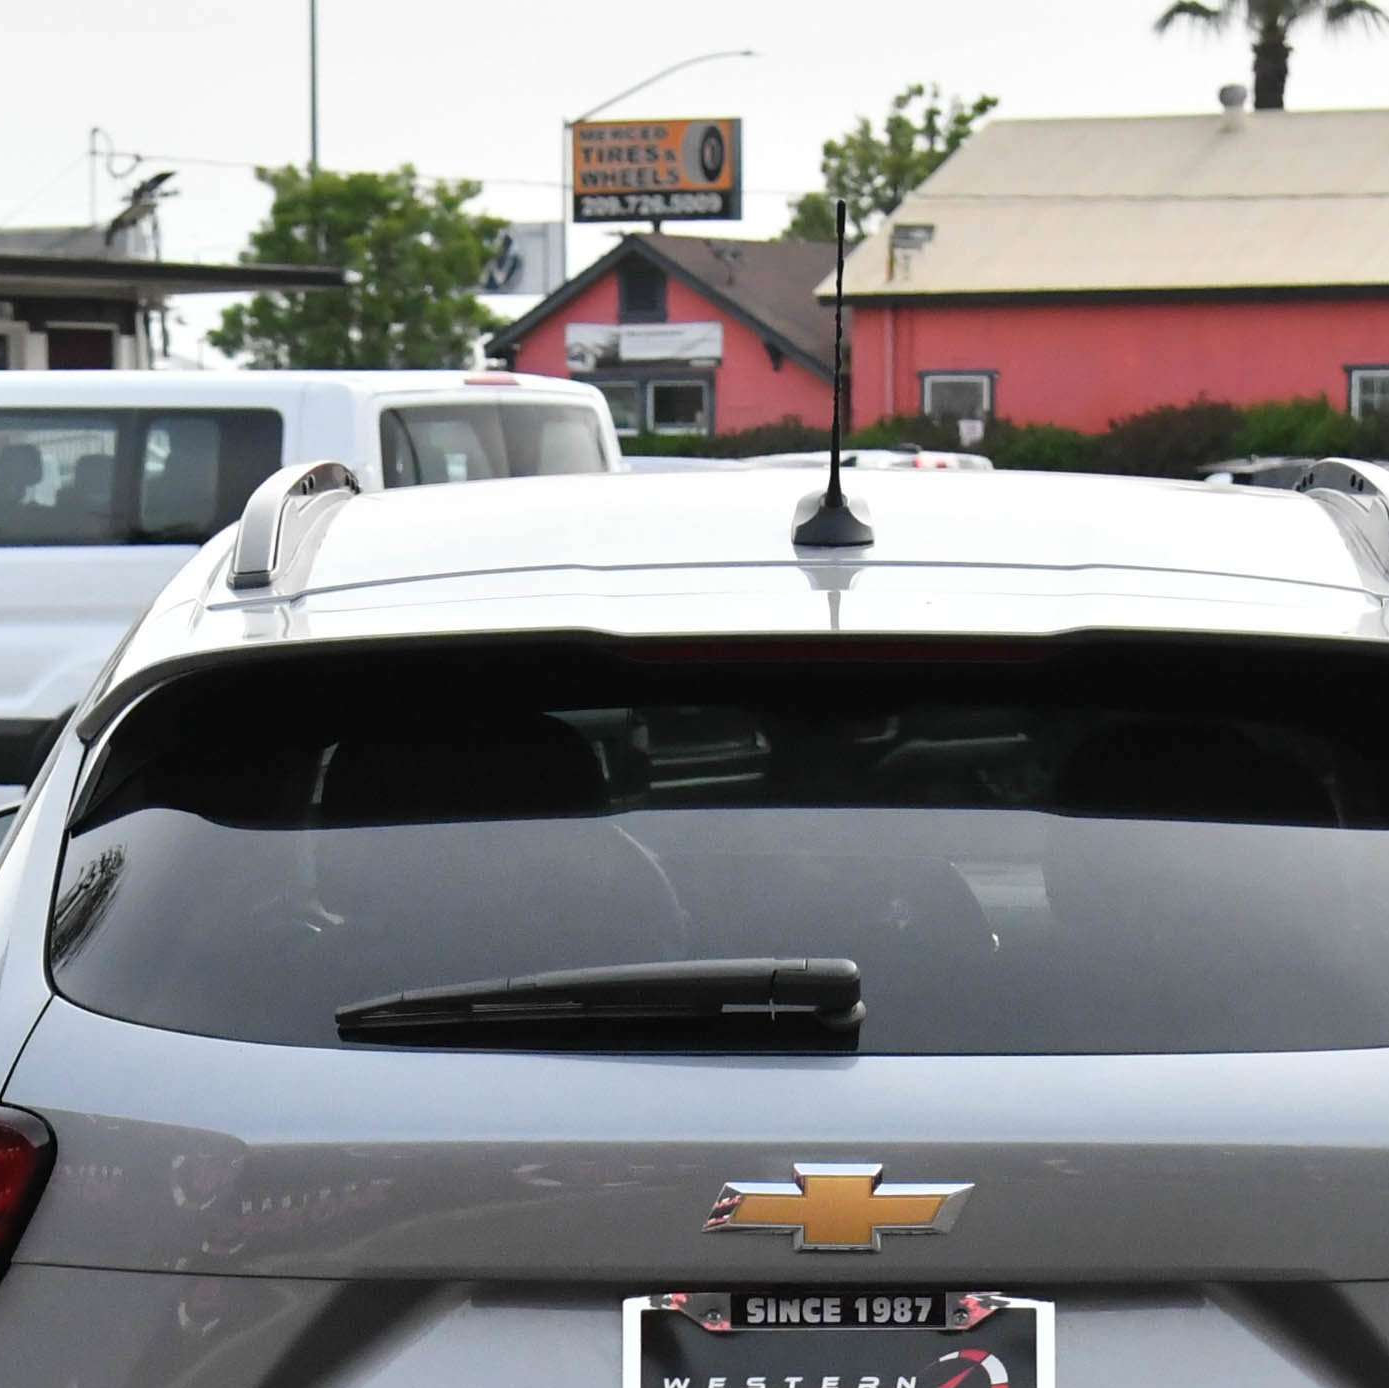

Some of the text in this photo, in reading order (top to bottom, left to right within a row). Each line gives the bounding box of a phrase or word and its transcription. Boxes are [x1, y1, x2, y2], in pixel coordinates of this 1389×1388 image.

[579, 126, 668, 141] MERCED
[581, 144, 659, 164] TIRES
[580, 166, 681, 187] WHEELS
[746, 1297, 932, 1325] SINCE 1987
